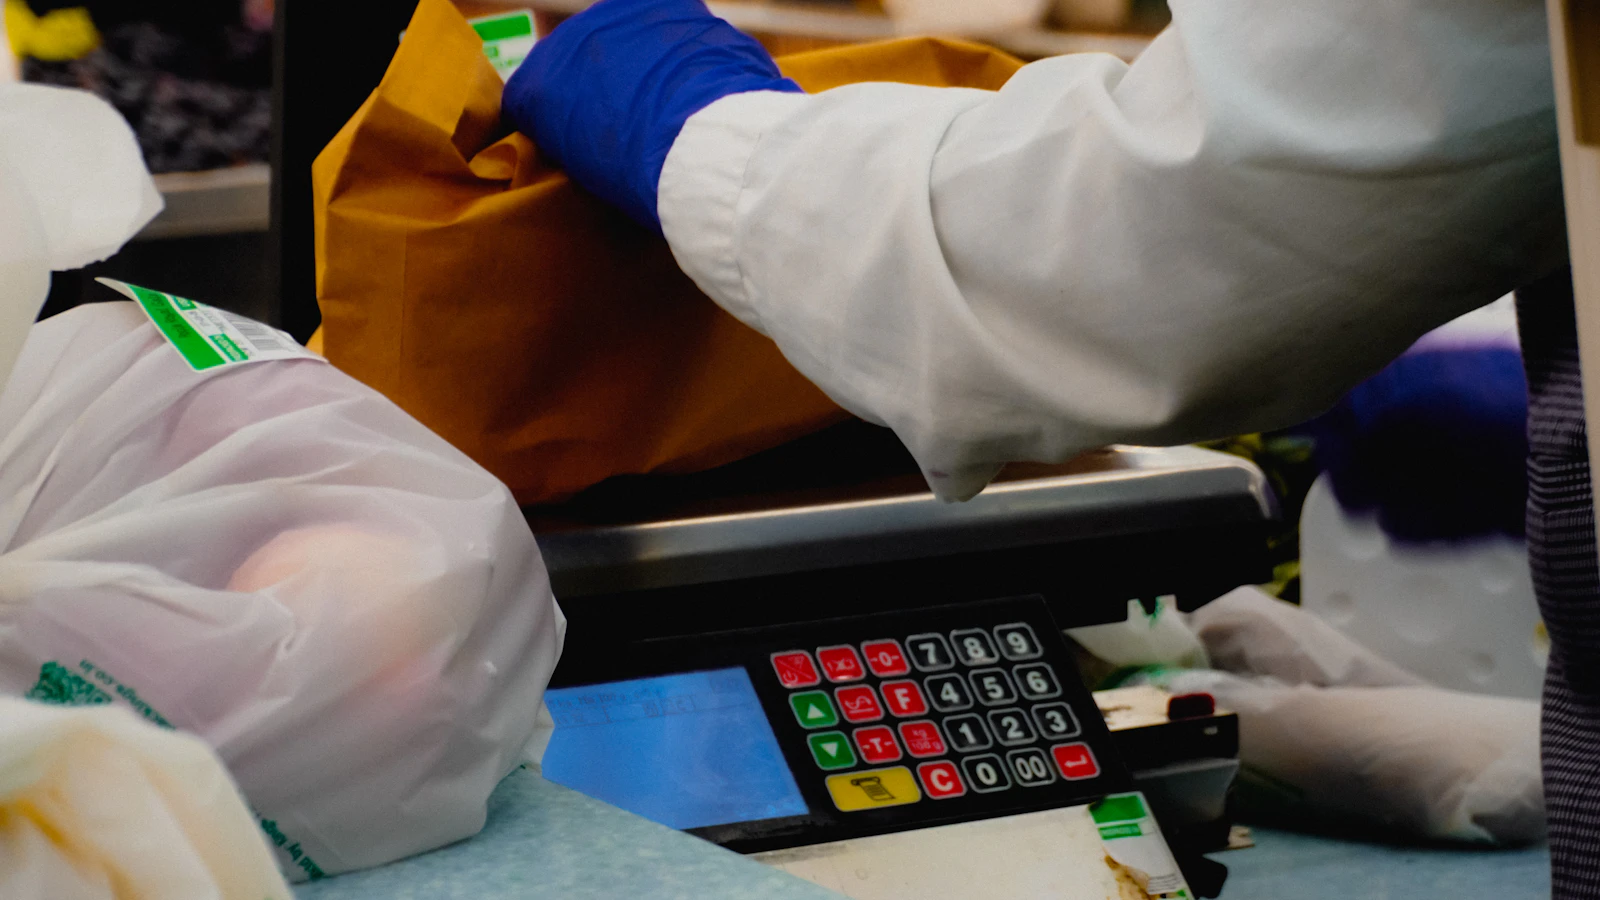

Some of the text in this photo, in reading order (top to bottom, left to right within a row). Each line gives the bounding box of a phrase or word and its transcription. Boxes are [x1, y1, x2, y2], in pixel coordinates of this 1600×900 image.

[919, 642, 937, 664] 7
[963, 637, 985, 658] 8
[1006, 632, 1029, 653] 9
[894, 671, 1048, 710] F 4 5 6
[958, 710, 1067, 744] 1 2 3
[930, 755, 1047, 792] C 0 00
